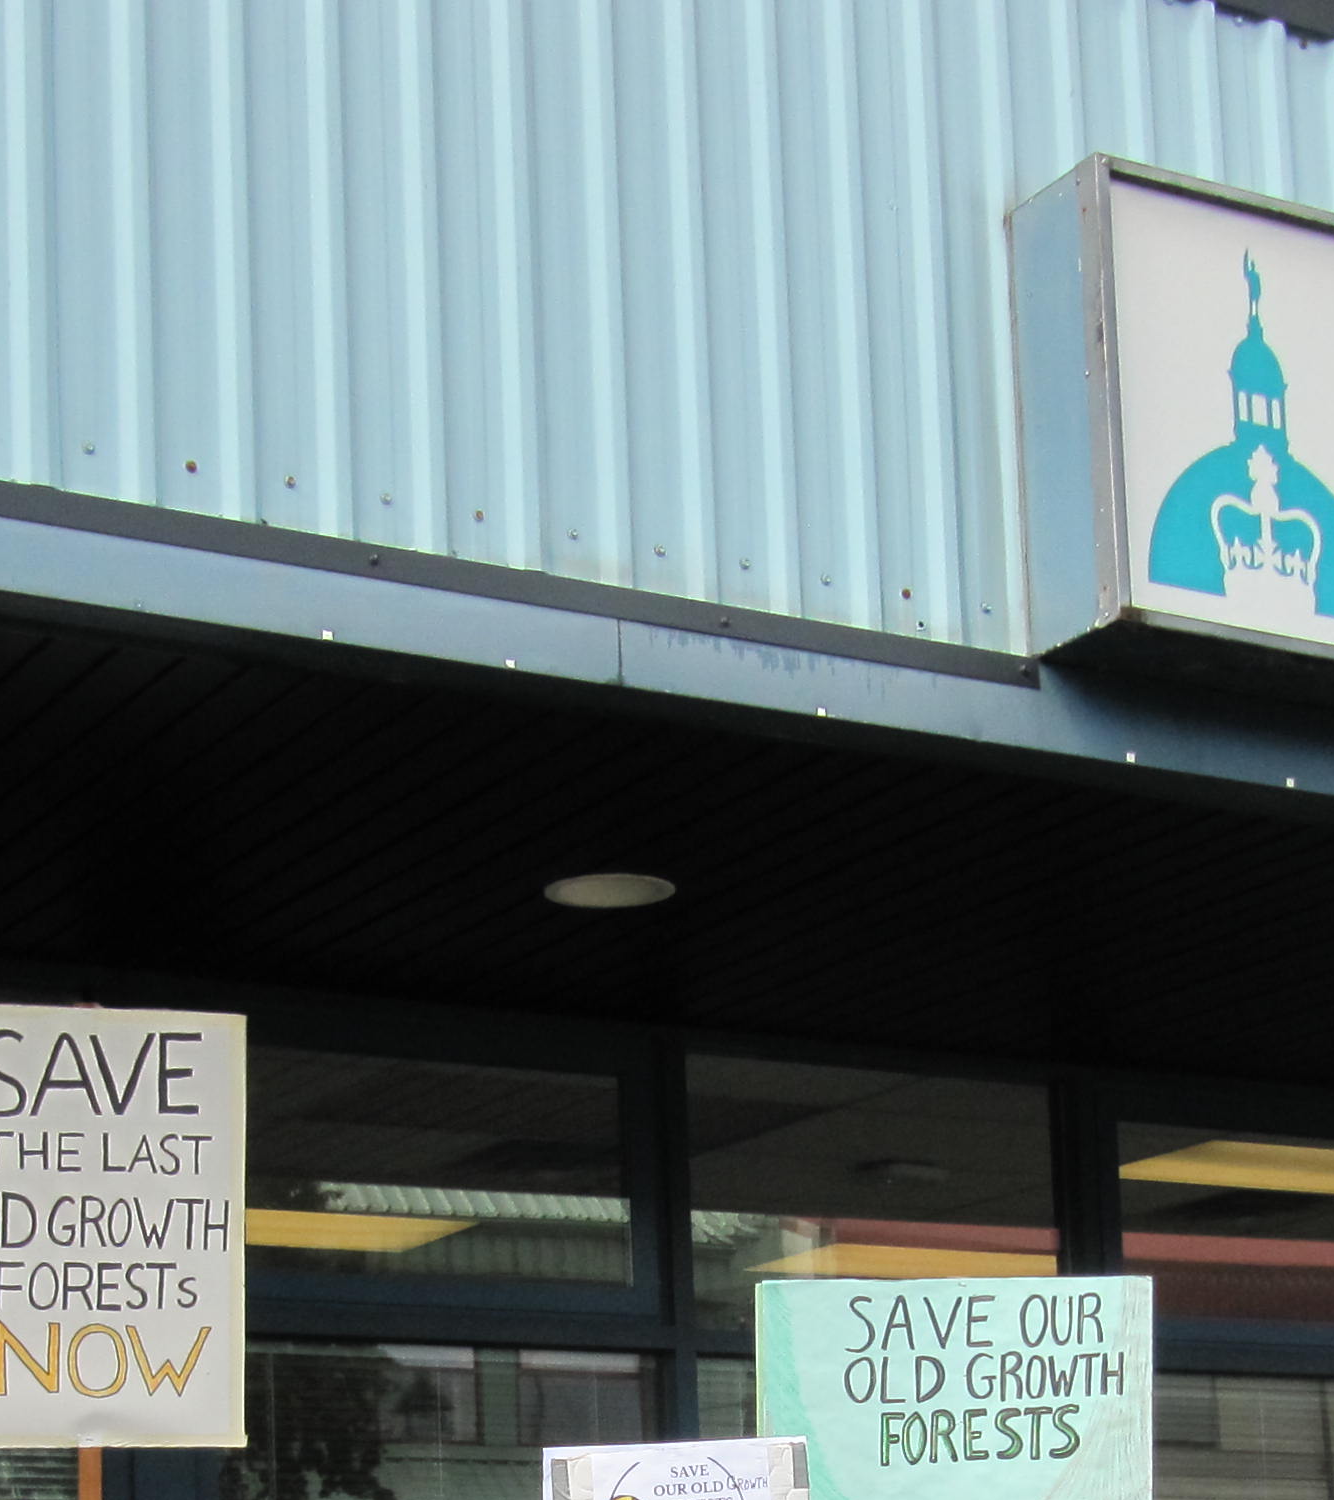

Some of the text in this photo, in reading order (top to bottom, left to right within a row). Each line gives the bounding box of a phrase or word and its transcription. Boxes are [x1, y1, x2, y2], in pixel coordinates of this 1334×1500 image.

[102, 1133, 213, 1176] LAST
[47, 1195, 230, 1252] GROWTH
[844, 1291, 1105, 1354] SAVE OUR
[843, 1350, 1126, 1404] OLD GROWTH
[880, 1403, 1082, 1467] FORESTS
[653, 1483, 686, 1497] OUR
[690, 1480, 724, 1494] OLD
[669, 1464, 710, 1479] SAVE
